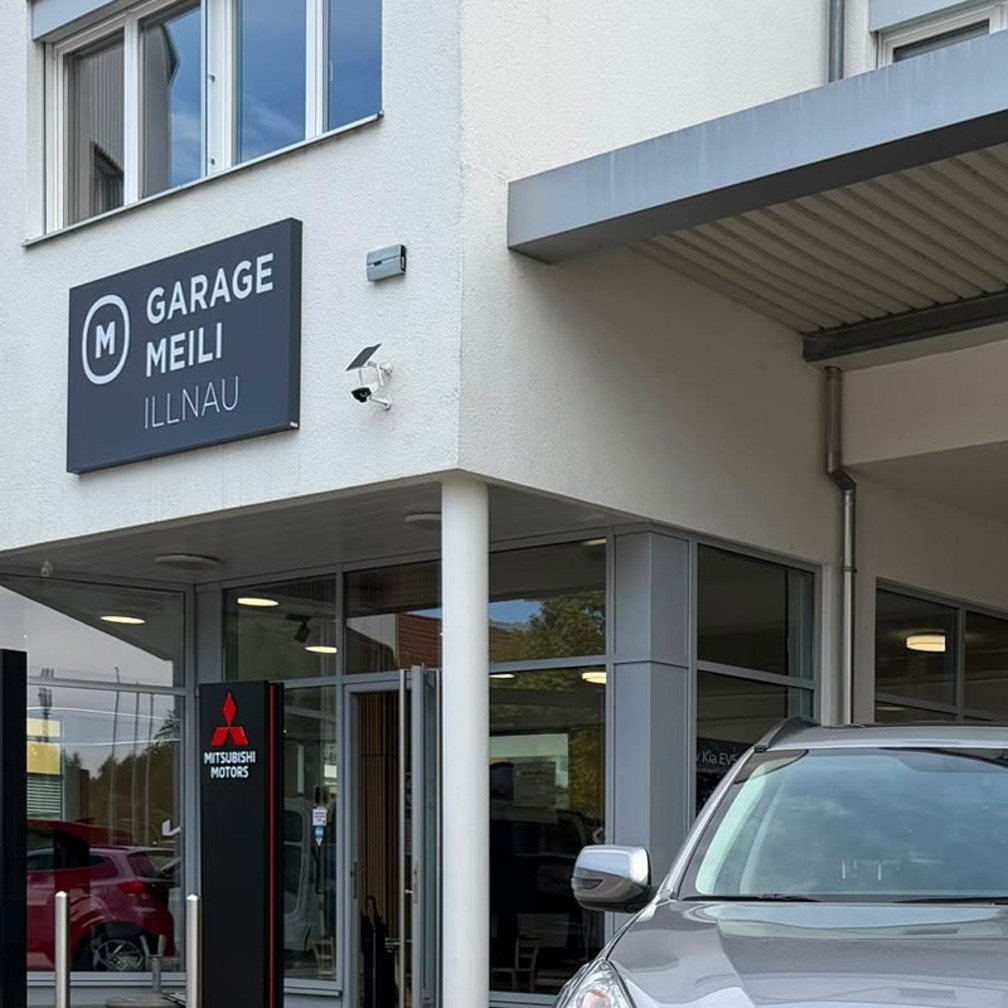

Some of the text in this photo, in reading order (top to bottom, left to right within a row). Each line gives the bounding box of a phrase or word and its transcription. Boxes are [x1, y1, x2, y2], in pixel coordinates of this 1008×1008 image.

[146, 253, 274, 325] GARAGE
[95, 320, 116, 359] M
[146, 322, 223, 377] MEILI
[145, 376, 240, 429] ILLNAU
[204, 751, 256, 764] MITSUBISHI
[211, 766, 249, 778] MOTORS
[702, 750, 717, 764] Kia
